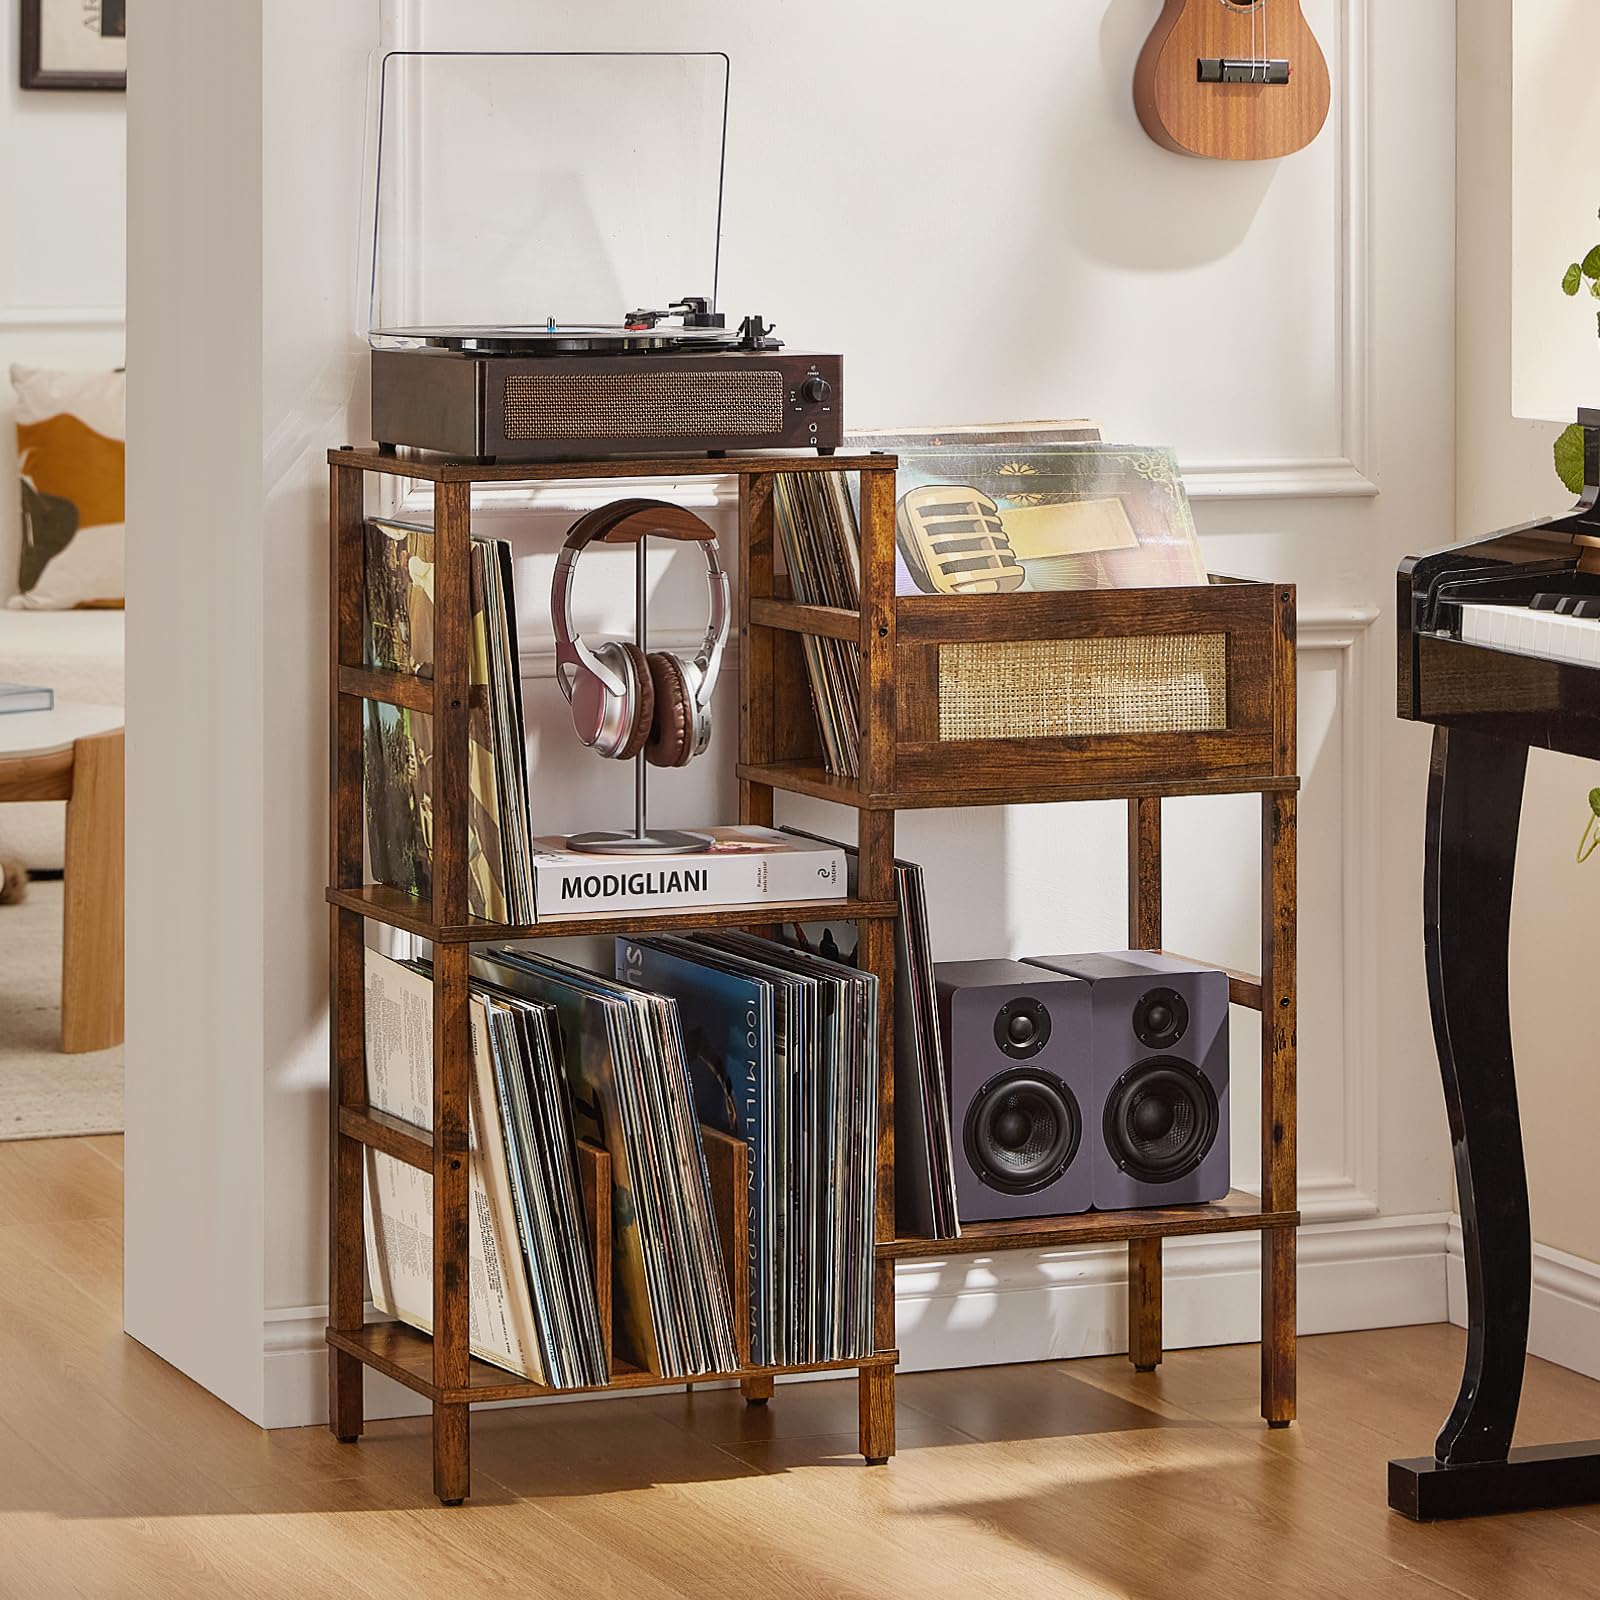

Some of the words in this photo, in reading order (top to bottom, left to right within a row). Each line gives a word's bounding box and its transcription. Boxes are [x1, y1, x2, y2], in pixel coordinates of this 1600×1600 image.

[561, 869, 708, 899] MODIGLIANI
[745, 999, 757, 1049] 100
[746, 1060, 757, 1192] MILLION
